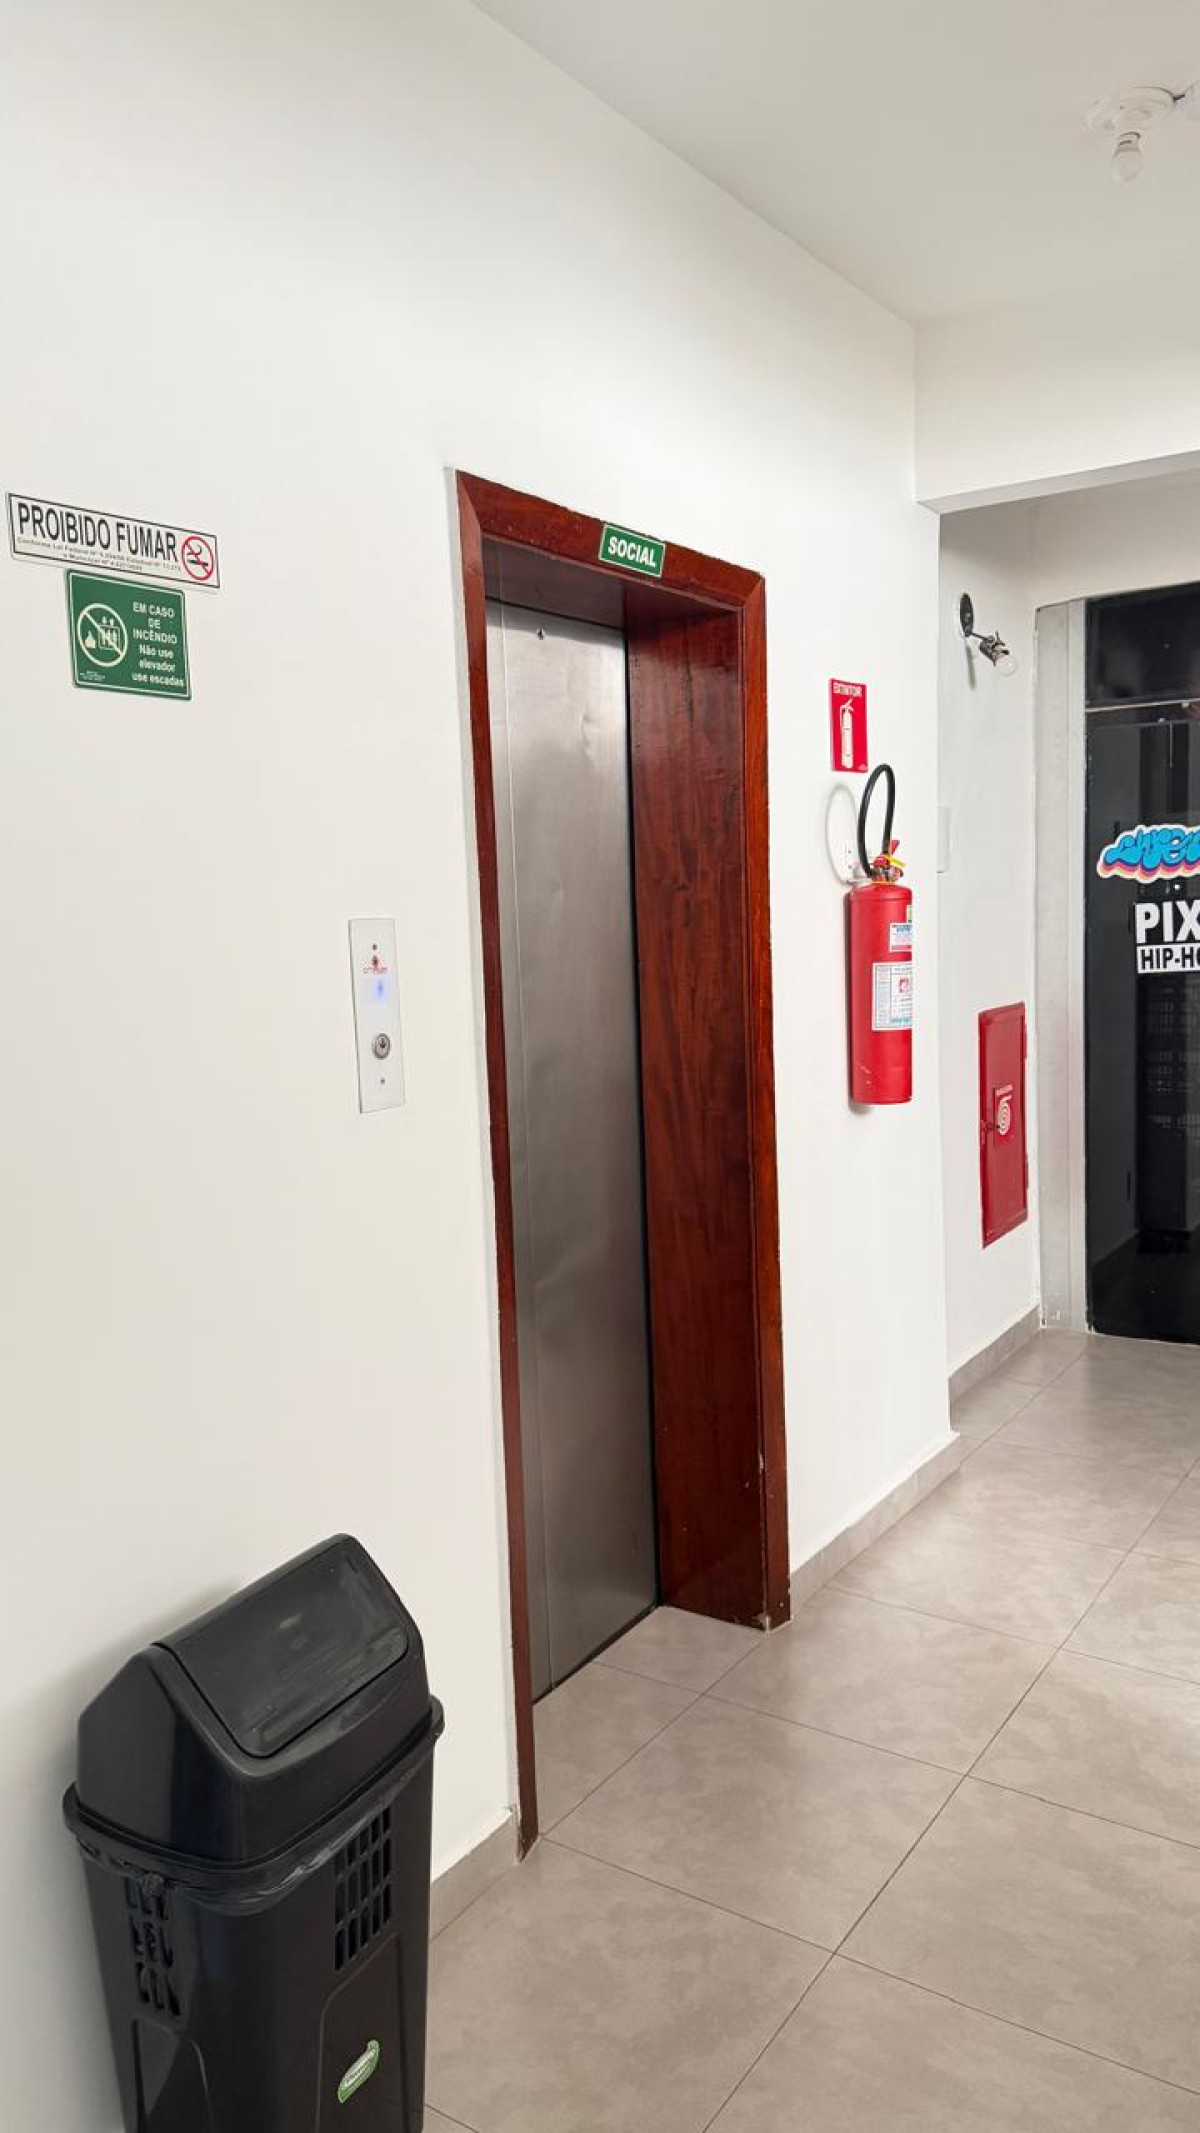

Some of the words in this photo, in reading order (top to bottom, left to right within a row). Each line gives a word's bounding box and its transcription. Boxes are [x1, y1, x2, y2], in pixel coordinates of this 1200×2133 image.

[17, 502, 111, 550] PROIBIDO
[115, 522, 178, 562] FUMAR
[608, 536, 657, 567] SOCIAL
[133, 601, 147, 614] EM
[149, 604, 175, 618] CASO
[148, 618, 160, 629] DE
[139, 644, 156, 656] Não
[158, 649, 174, 659] use
[139, 658, 175, 672] elevador
[132, 672, 147, 682] use
[149, 674, 184, 687] escadas
[1134, 900, 1200, 943] PIX
[1141, 946, 1200, 971] HIP-H
